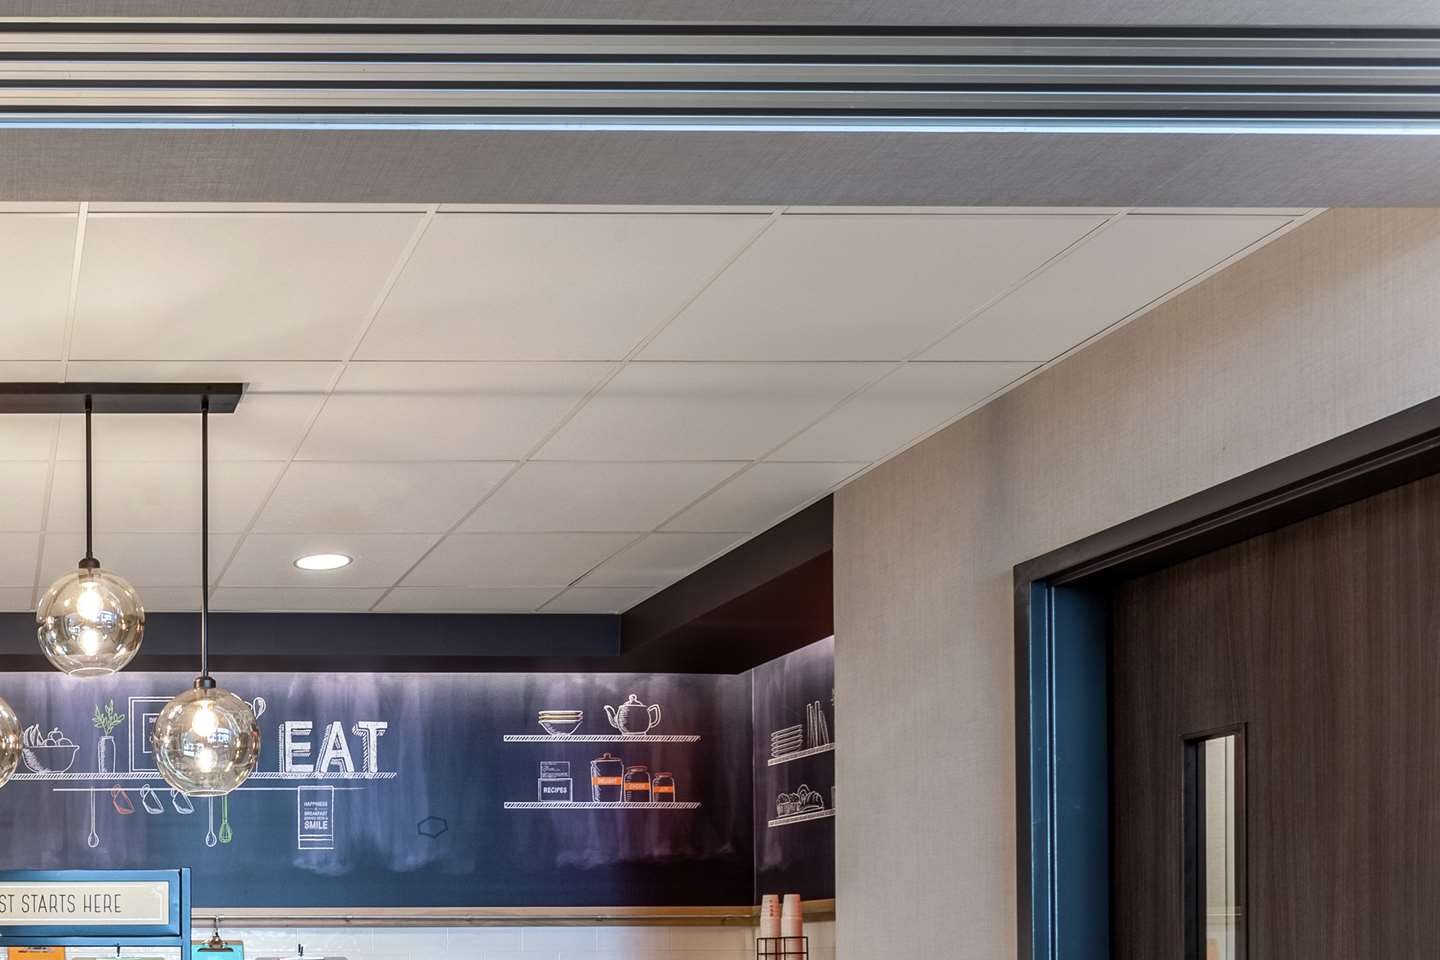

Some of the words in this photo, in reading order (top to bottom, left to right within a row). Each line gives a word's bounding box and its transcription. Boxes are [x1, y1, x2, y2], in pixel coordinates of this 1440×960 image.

[279, 720, 388, 776] EAT
[543, 786, 568, 794] RECIPES
[304, 820, 328, 830] SMILE
[21, 894, 76, 914] STARTS
[83, 893, 121, 914] HERE
